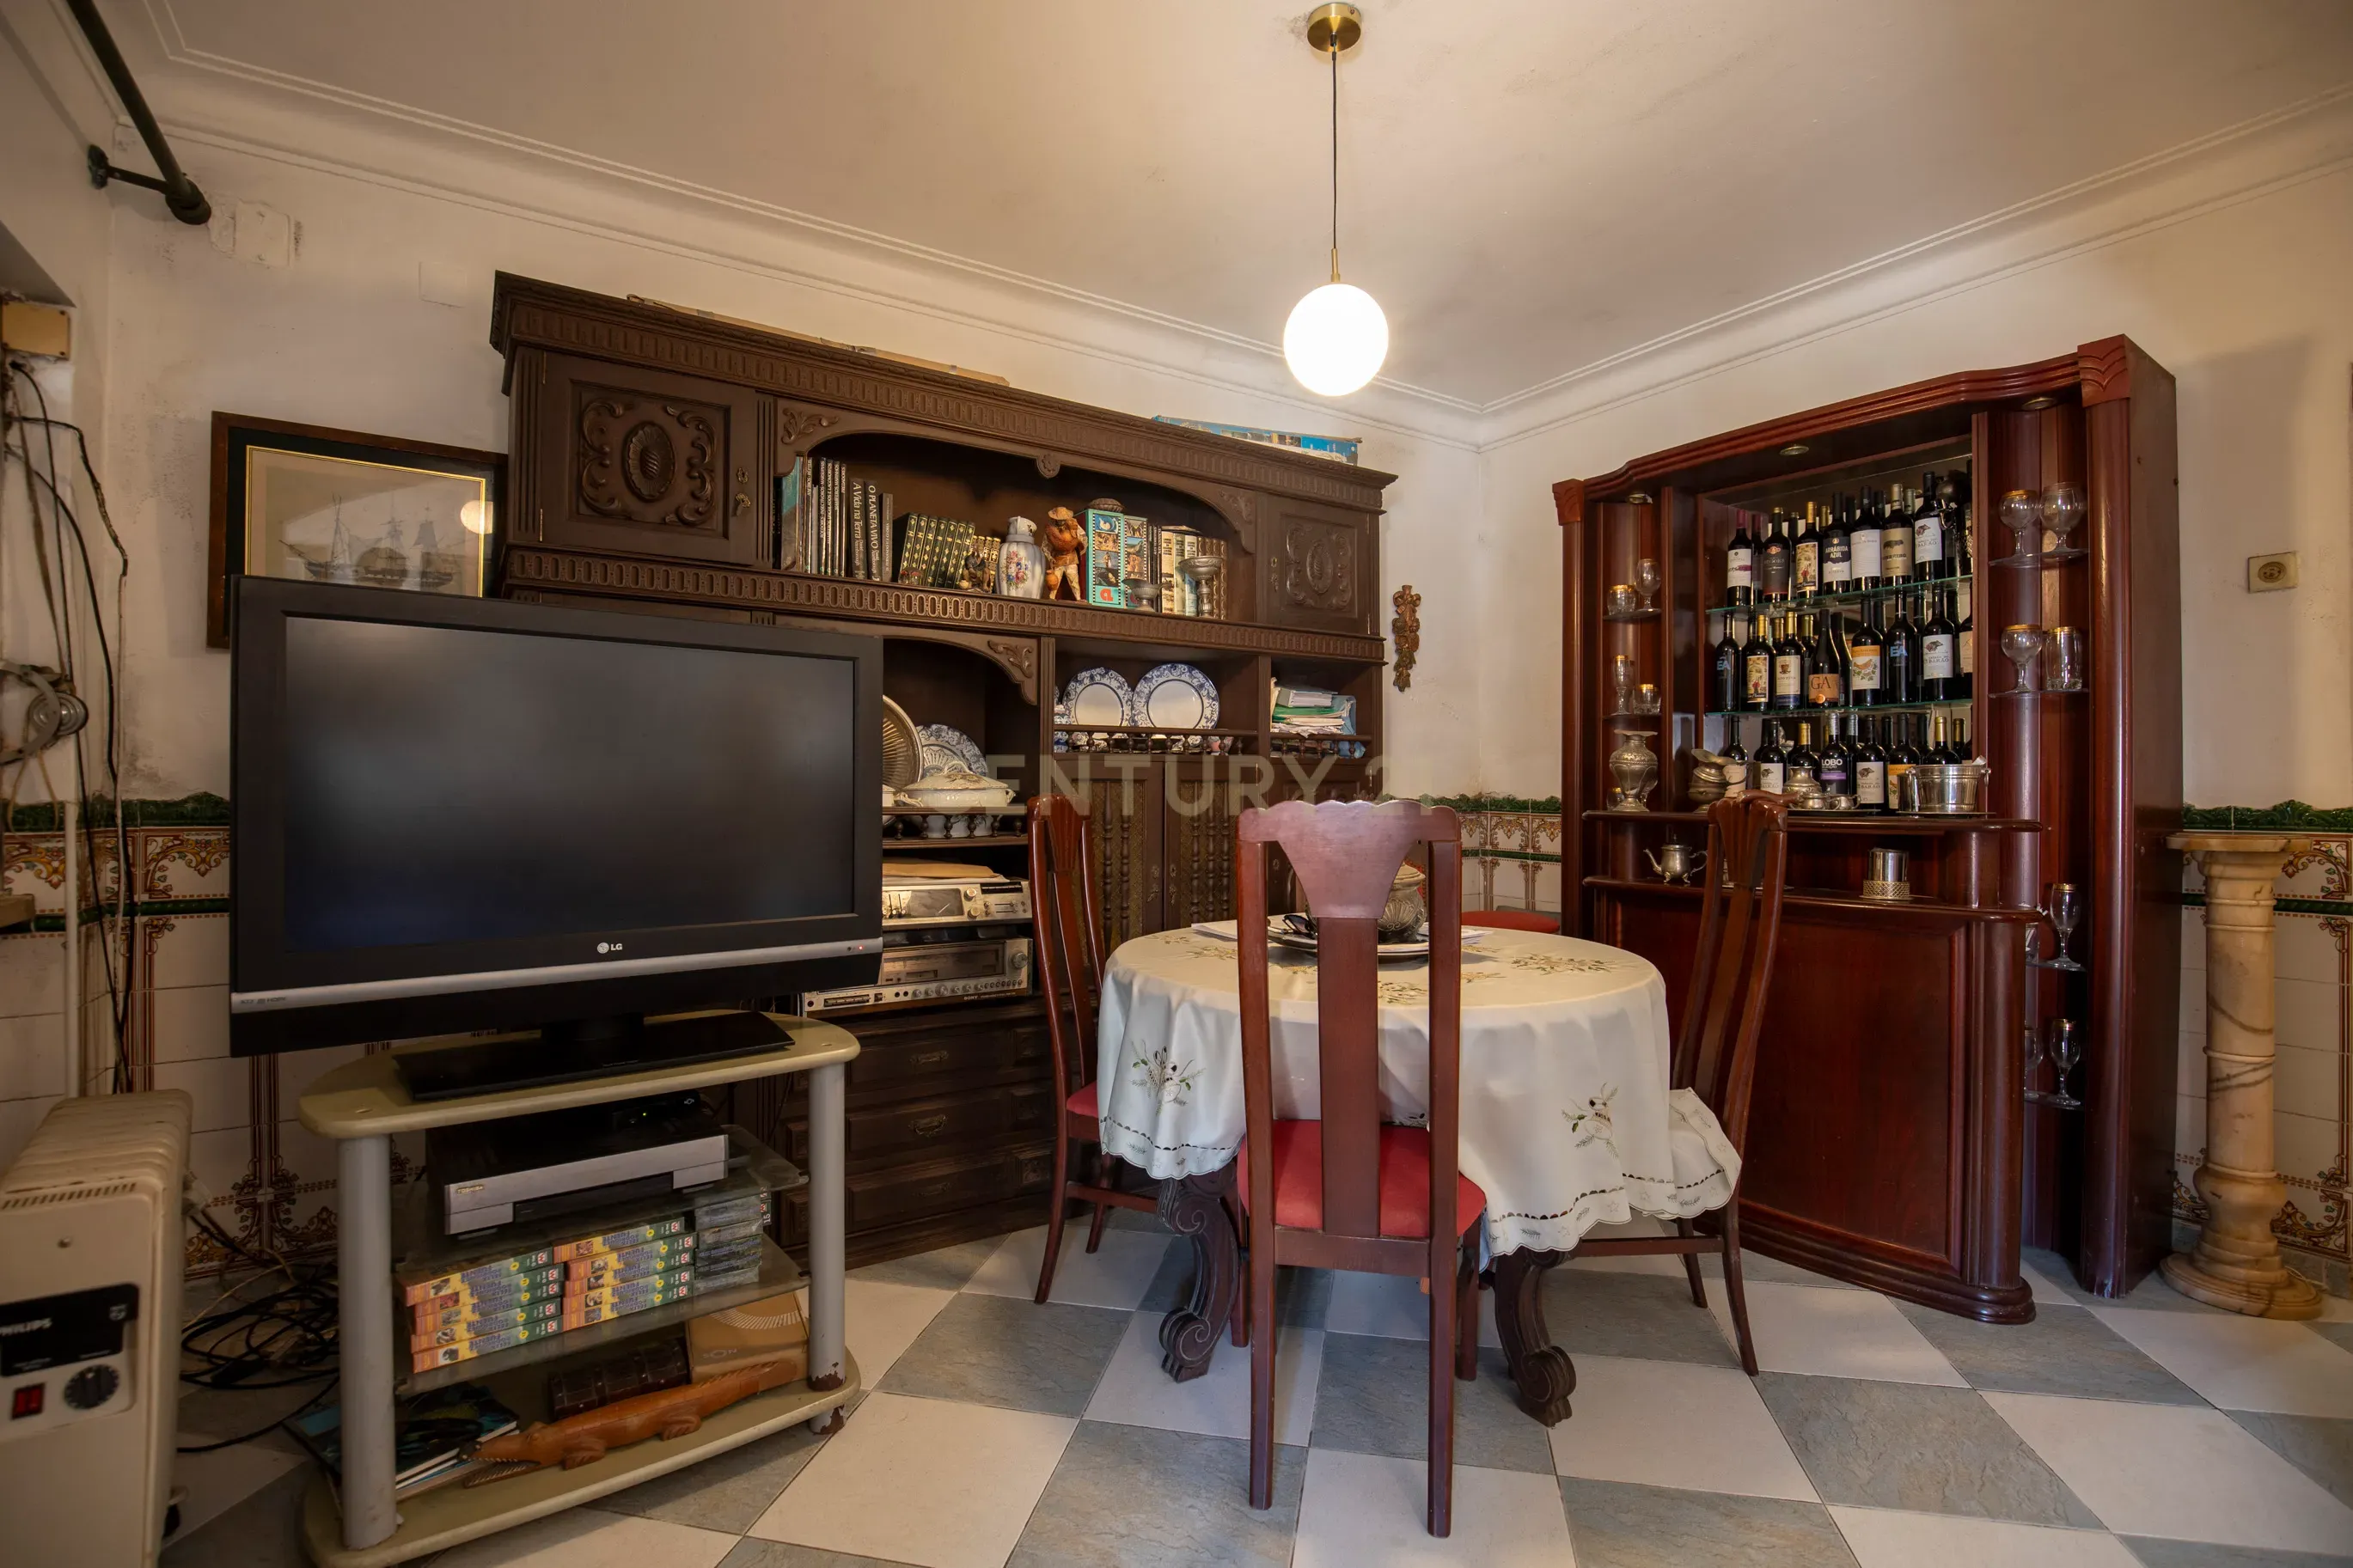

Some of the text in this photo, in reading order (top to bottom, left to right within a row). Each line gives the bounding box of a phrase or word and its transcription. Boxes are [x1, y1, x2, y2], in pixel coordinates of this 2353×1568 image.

[853, 482, 863, 539] A Vida na Terra
[868, 494, 877, 528] PLANETA
[1825, 545, 1849, 553] ARRÁBIDA
[1890, 645, 1908, 657] EA
[1821, 758, 1843, 766] LOBO
[610, 943, 623, 951] LG
[456, 1185, 484, 1194] TOSHIBA
[763, 1213, 771, 1223] 15
[702, 1347, 738, 1359] NOS
